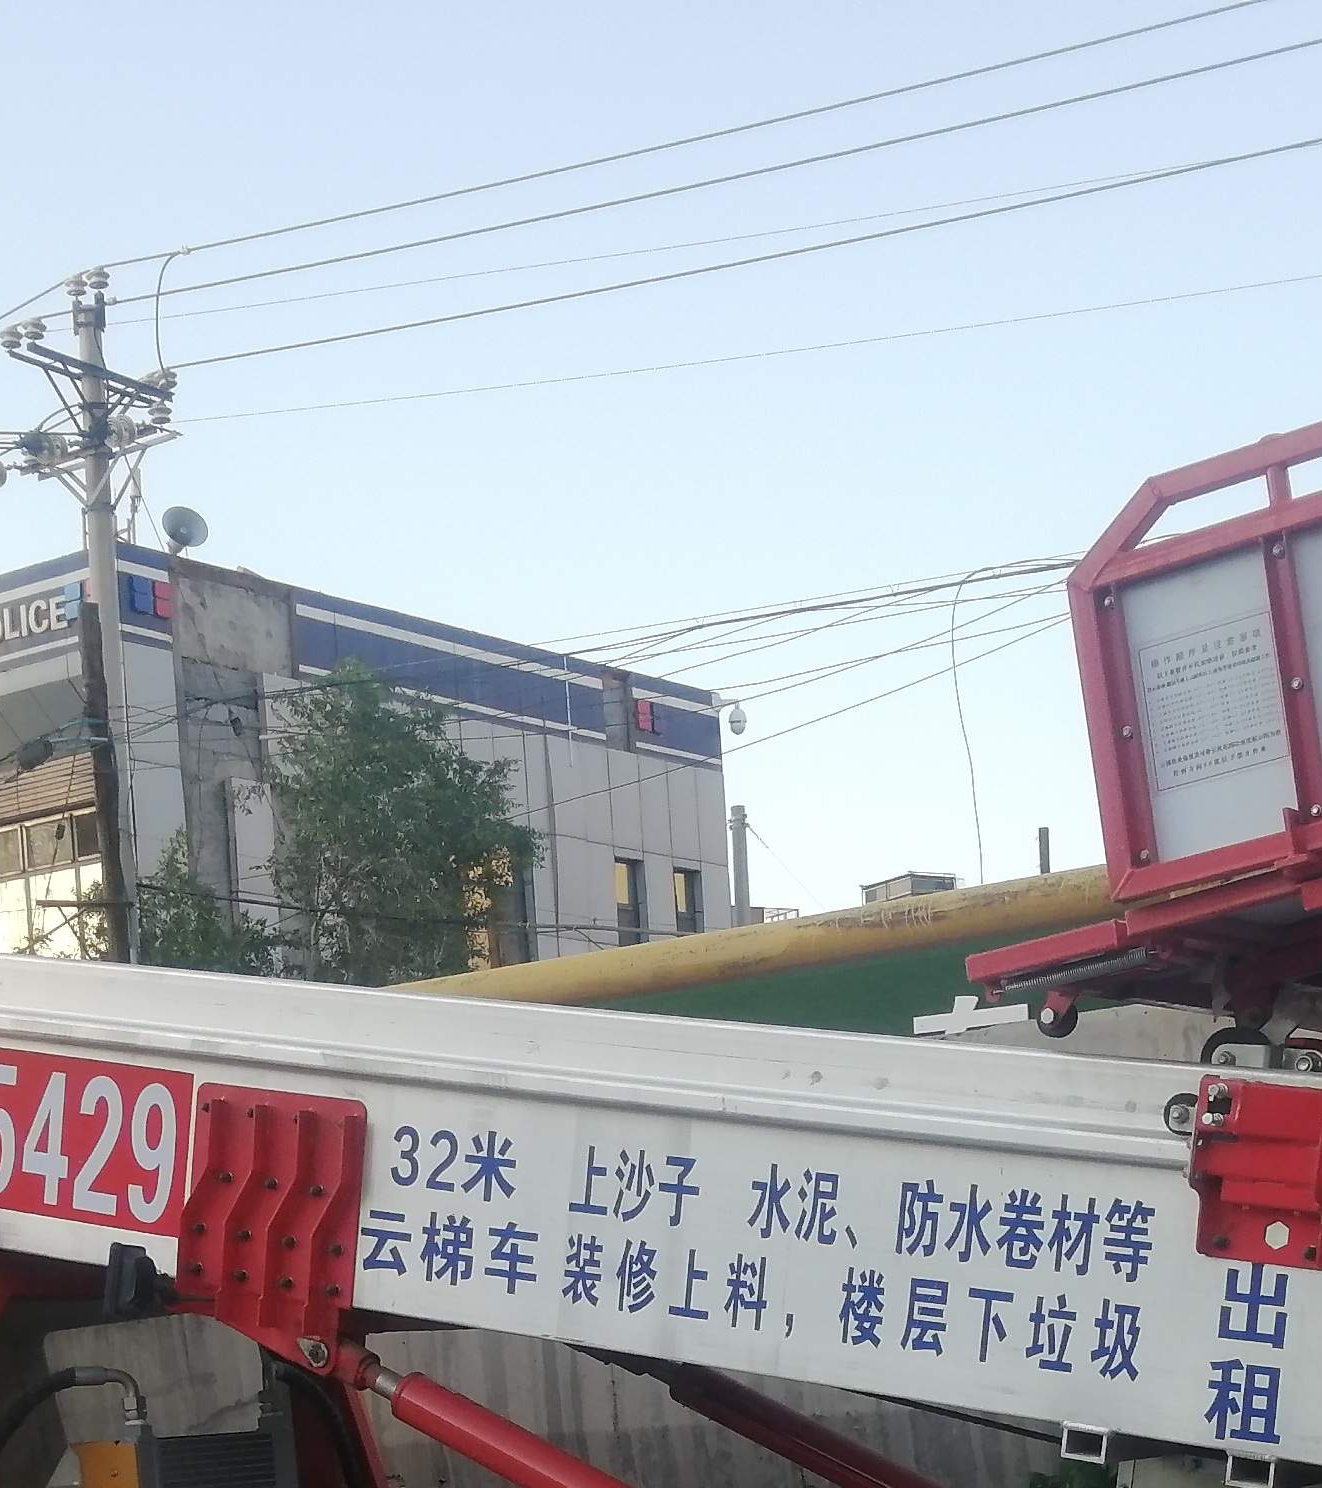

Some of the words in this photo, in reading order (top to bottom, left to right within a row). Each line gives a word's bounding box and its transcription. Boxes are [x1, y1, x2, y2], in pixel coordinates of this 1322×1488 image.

[390, 1125, 516, 1202] 32米
[568, 1145, 700, 1227] 上沙子
[1207, 1265, 1286, 1444] 出租
